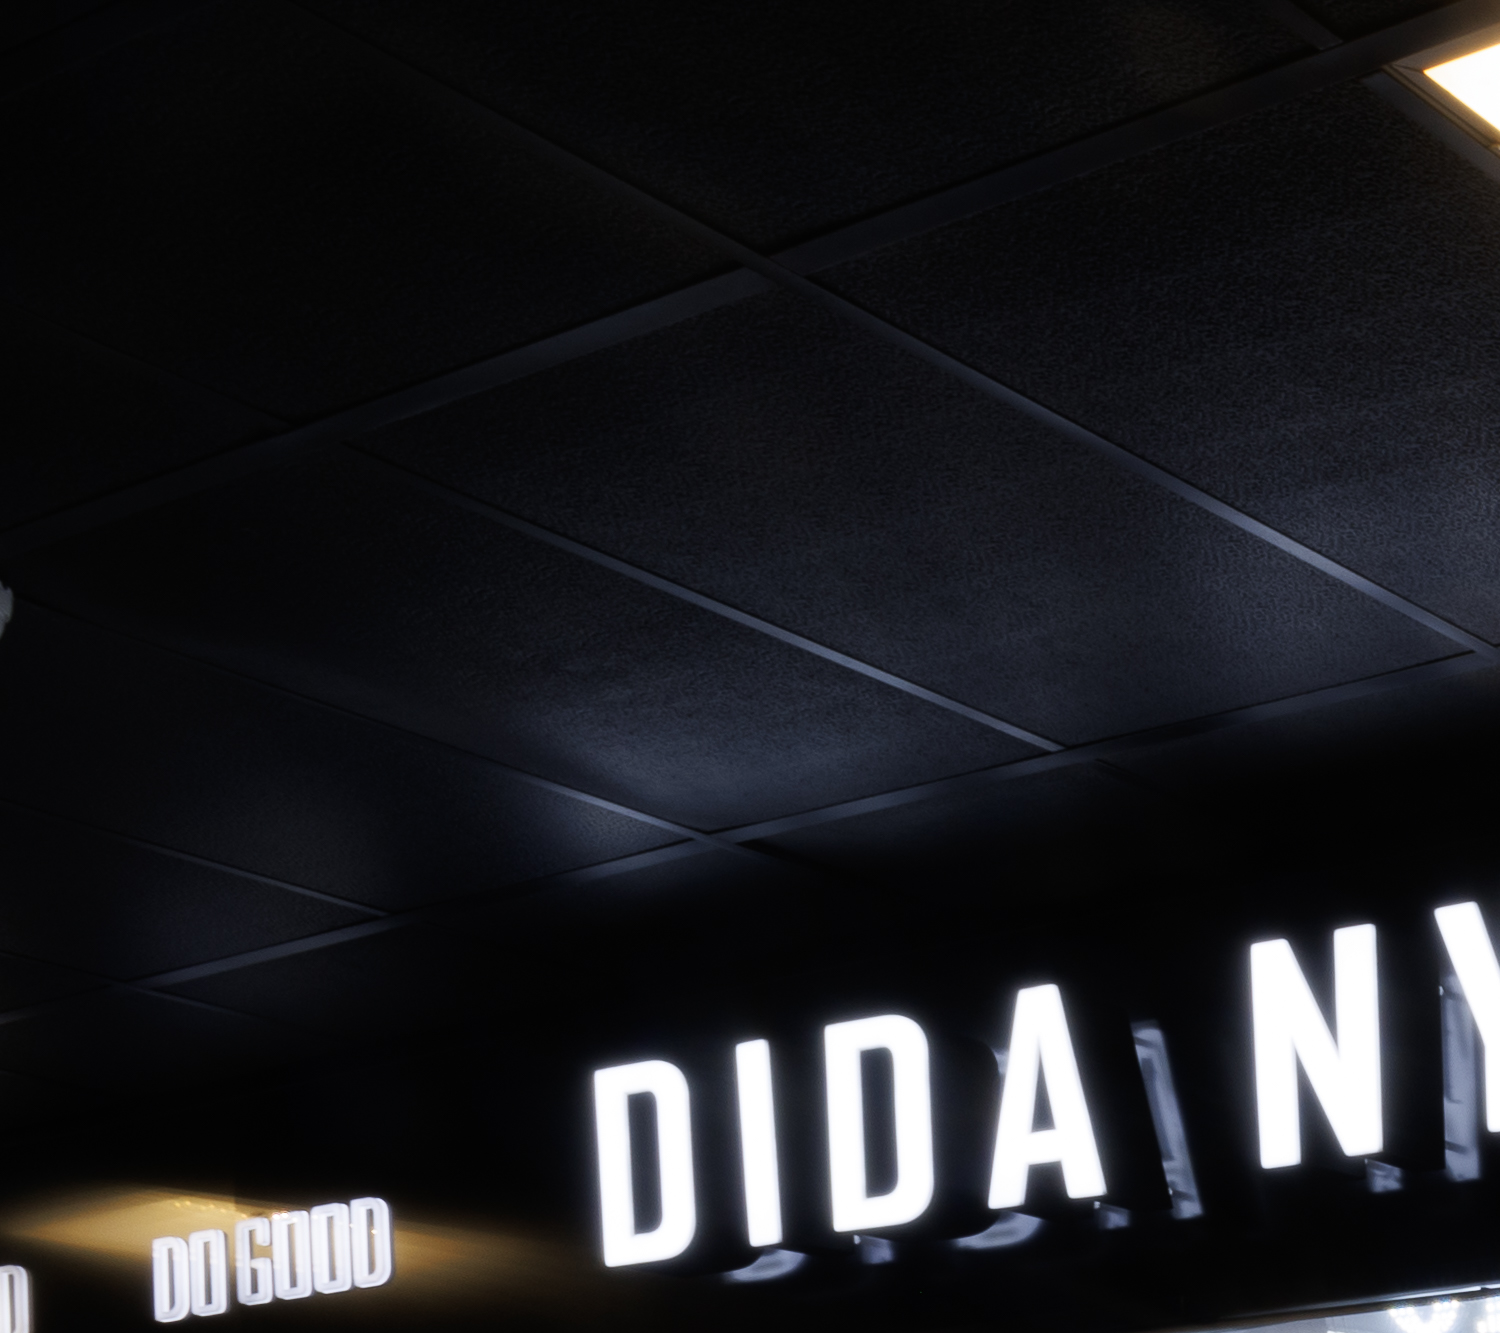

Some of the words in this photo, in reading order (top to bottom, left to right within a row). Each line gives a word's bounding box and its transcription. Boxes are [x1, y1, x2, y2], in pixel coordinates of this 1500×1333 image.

[593, 983, 1107, 1268] DIDA
[152, 1228, 229, 1323] DO
[235, 1196, 393, 1306] GOOD
